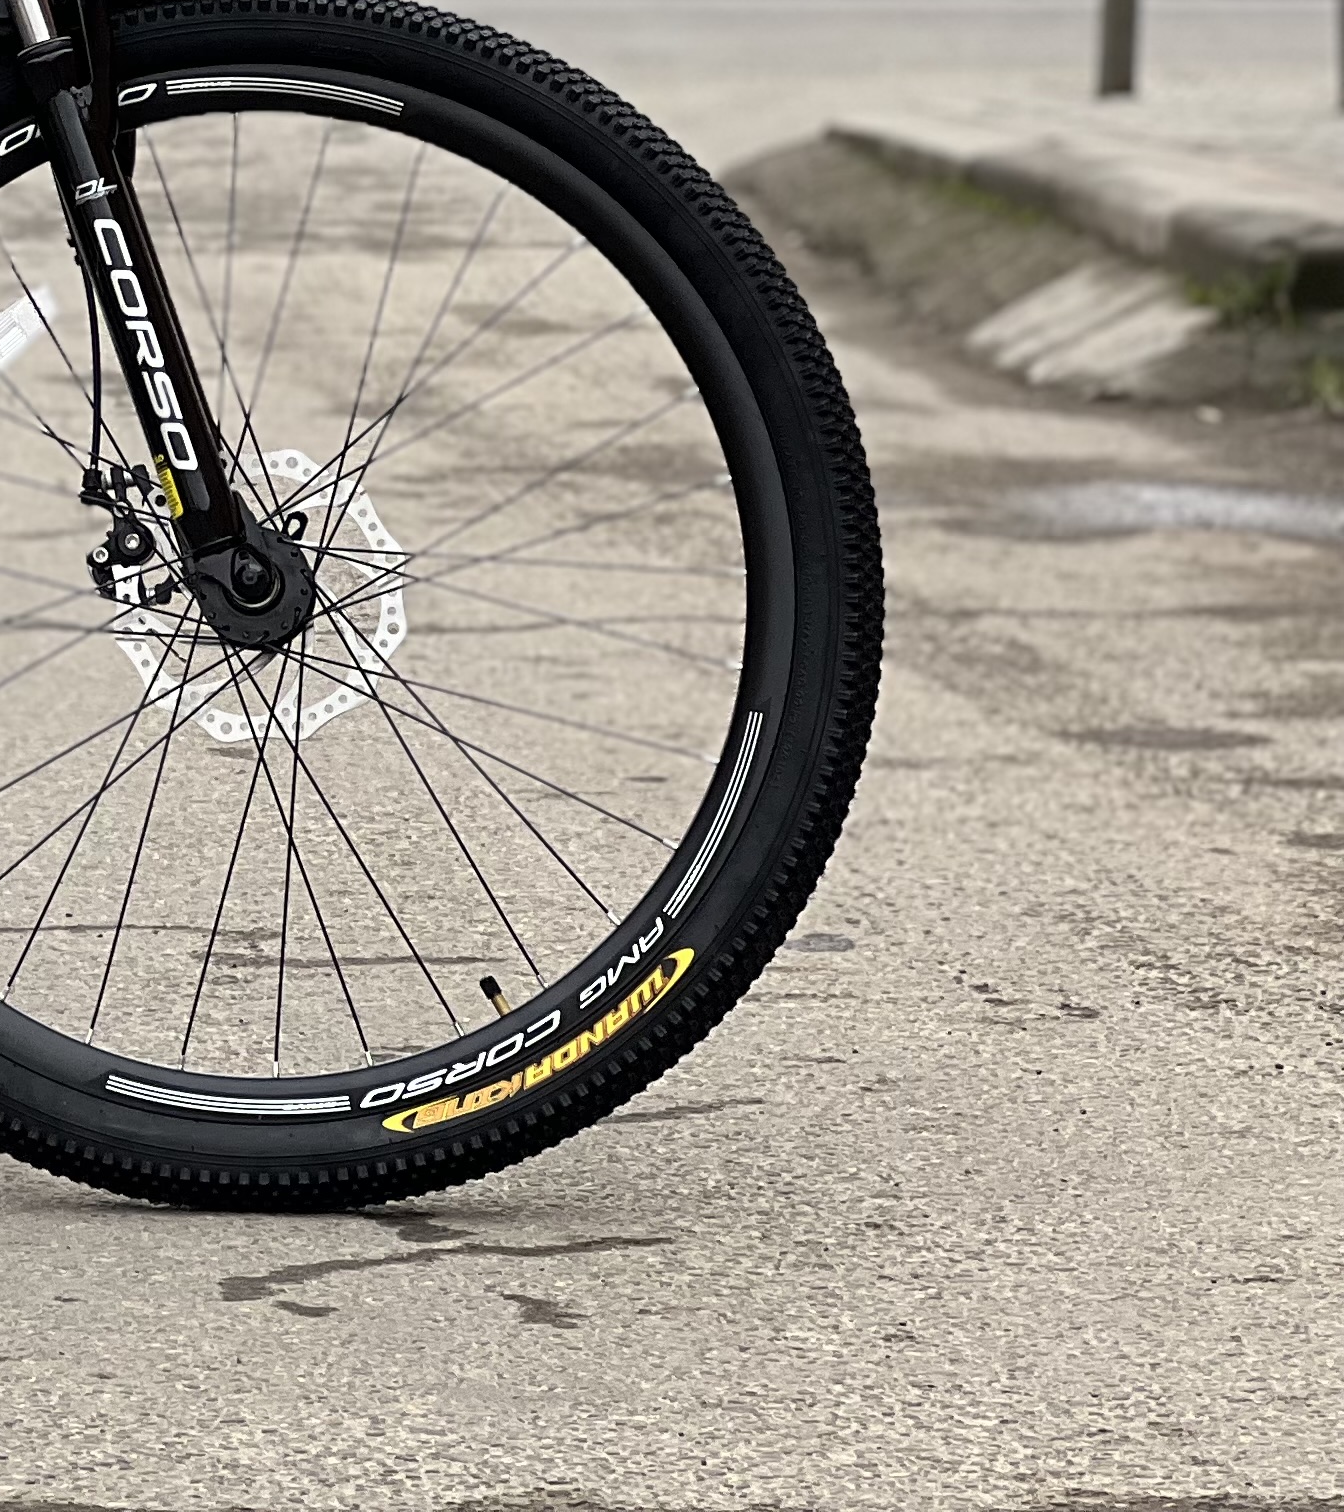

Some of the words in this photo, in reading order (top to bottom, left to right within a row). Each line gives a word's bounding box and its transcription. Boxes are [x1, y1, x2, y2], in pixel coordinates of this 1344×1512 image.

[93, 218, 199, 472] CORSO
[579, 916, 664, 1009] AMG
[359, 1009, 561, 1109] CORSO
